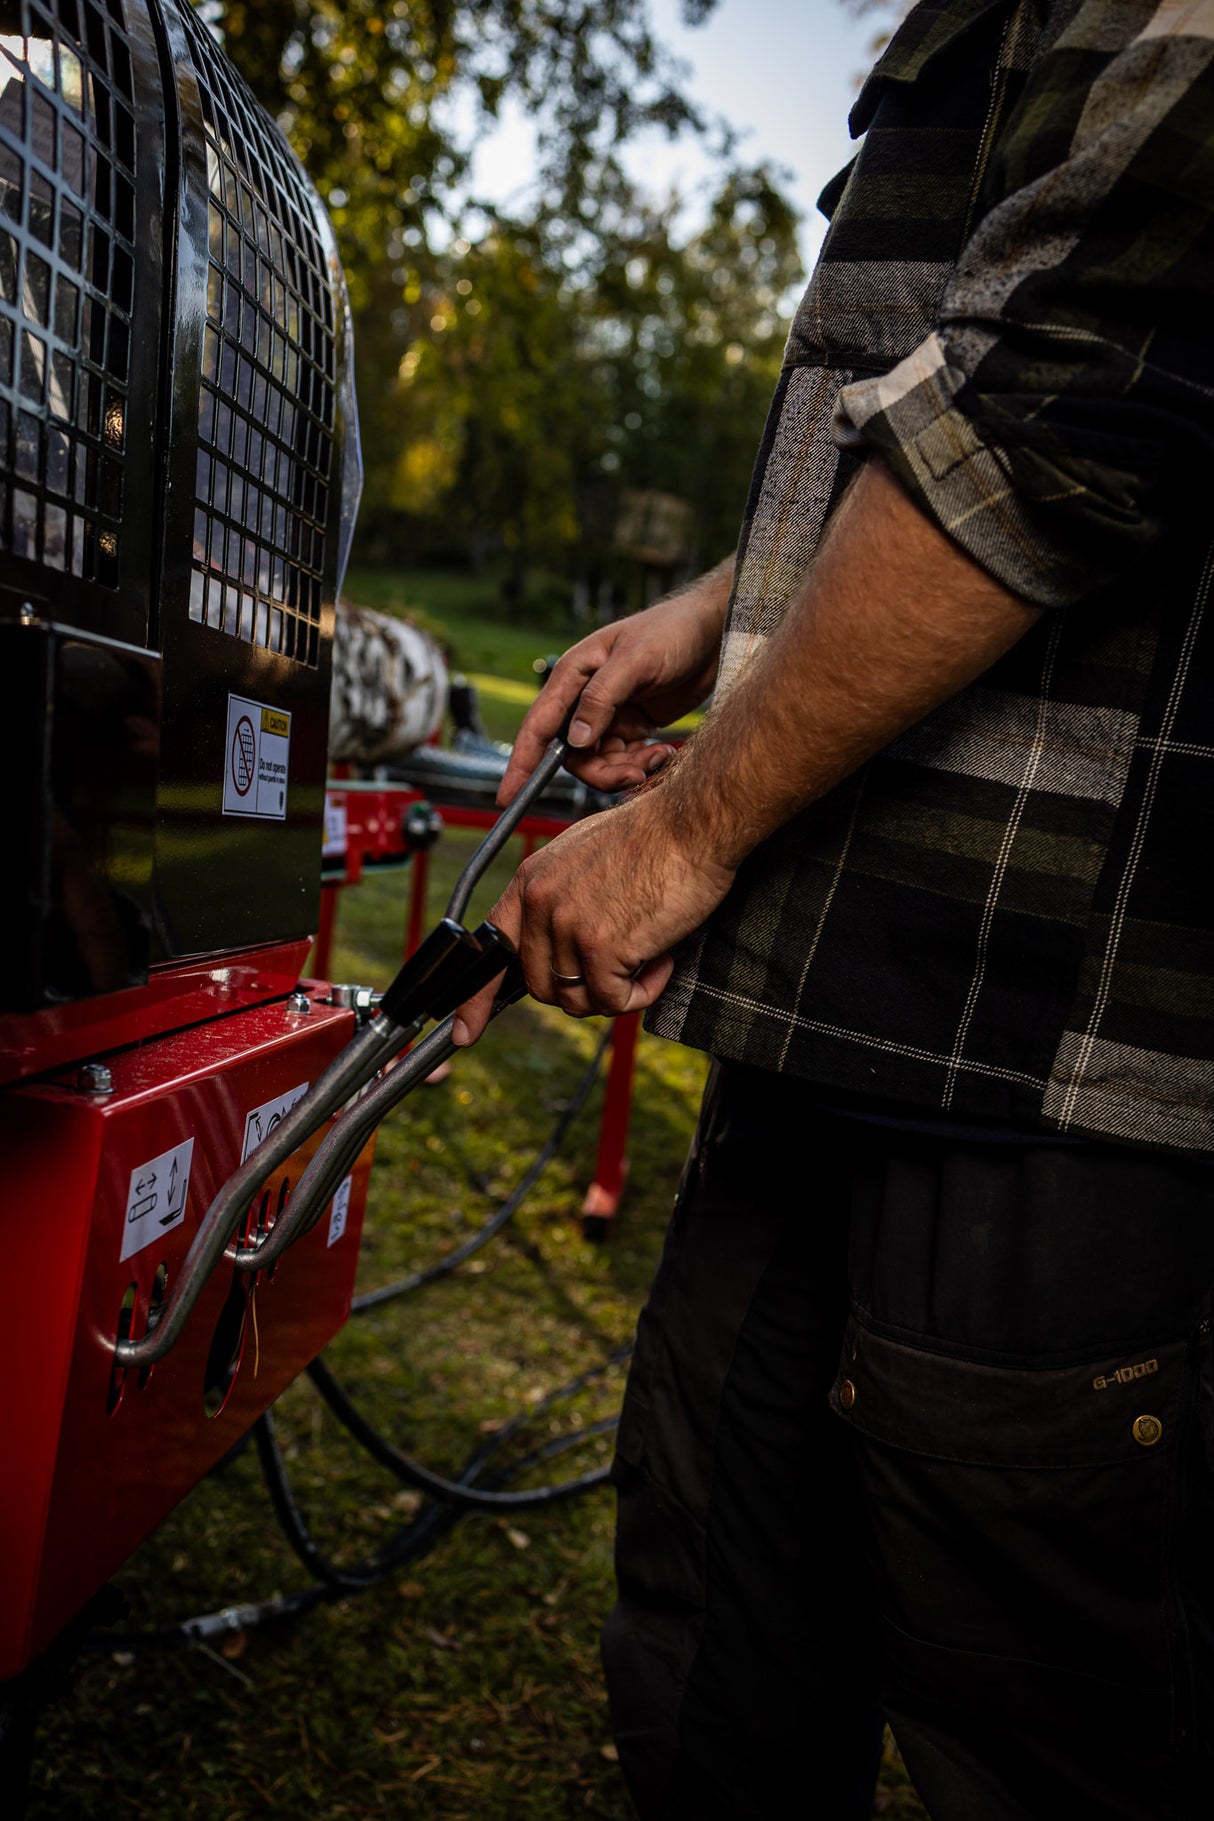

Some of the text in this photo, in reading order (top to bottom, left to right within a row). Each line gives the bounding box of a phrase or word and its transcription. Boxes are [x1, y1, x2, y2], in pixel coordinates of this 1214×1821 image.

[270, 717, 287, 731] CAUTION
[259, 757, 265, 770] Do
[273, 763, 286, 775] operate
[1092, 1358, 1159, 1391] G-1000
